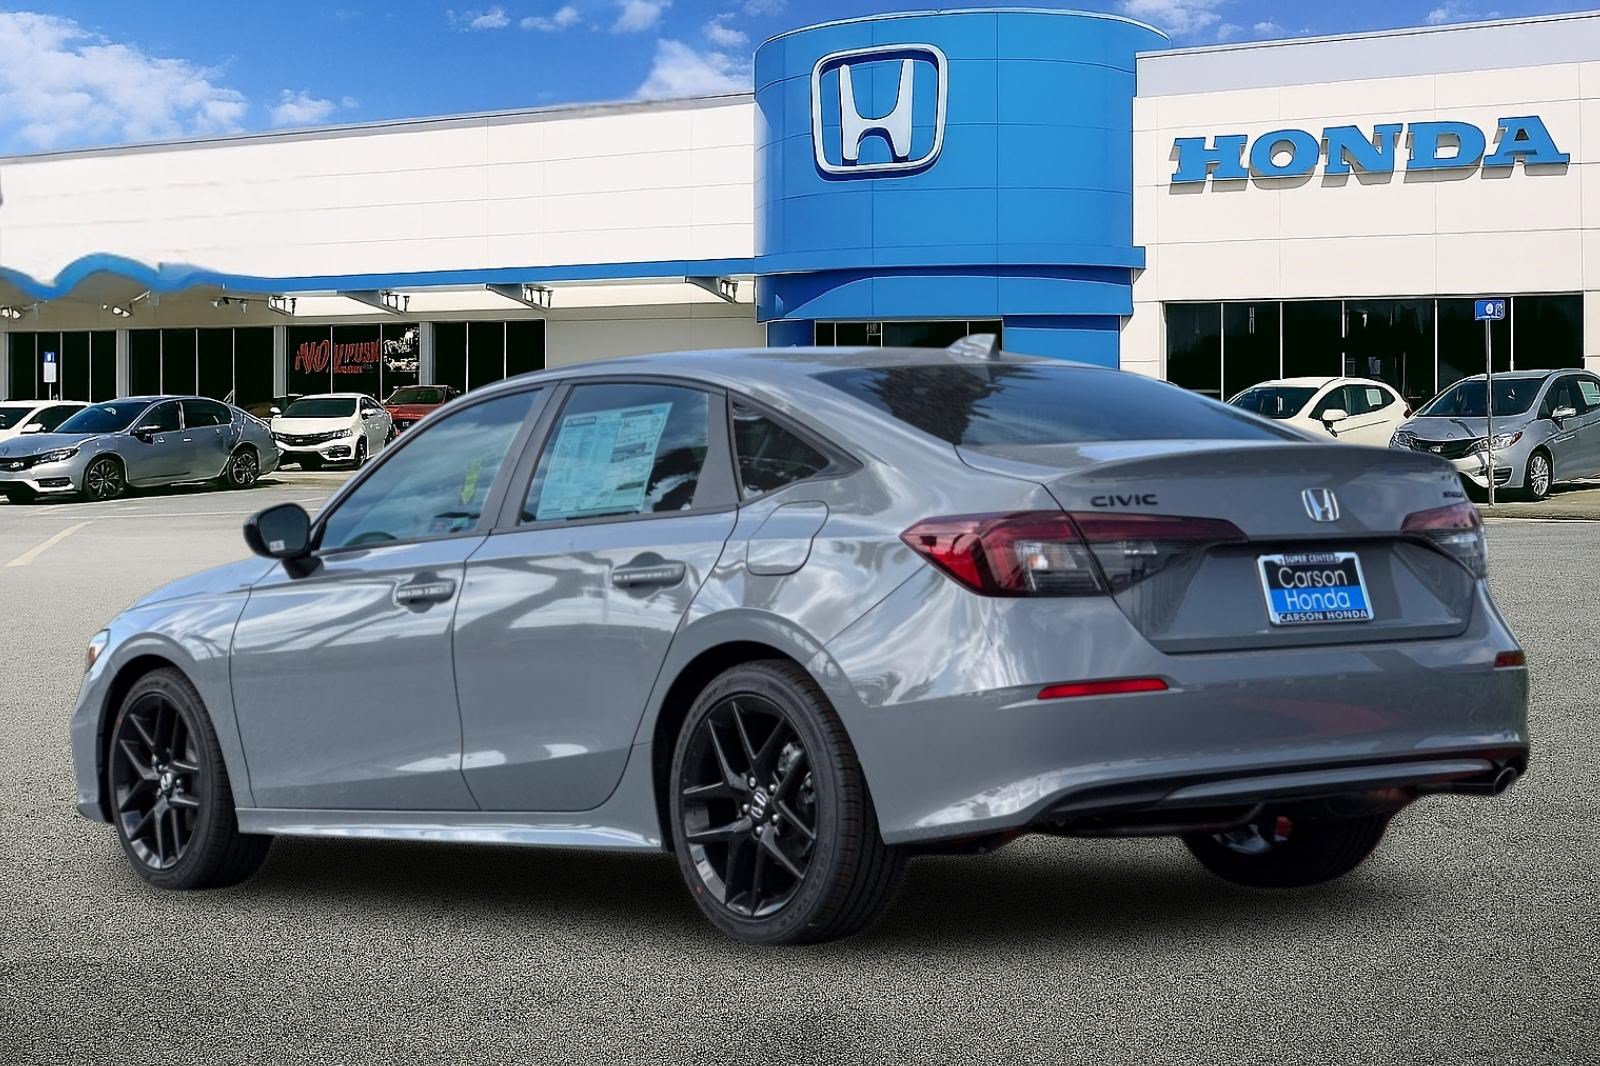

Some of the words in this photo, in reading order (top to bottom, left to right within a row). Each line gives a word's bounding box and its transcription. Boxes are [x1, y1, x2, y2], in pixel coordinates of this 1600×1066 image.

[1171, 115, 1570, 183] HONDA
[1090, 493, 1159, 508] CIVIC
[1284, 554, 1307, 564] SUPER
[1308, 553, 1335, 563] CENTER
[1278, 566, 1348, 589] Carson
[1284, 587, 1351, 610] Honda
[1279, 612, 1324, 622] CARSON
[1326, 610, 1369, 621] HONDA
